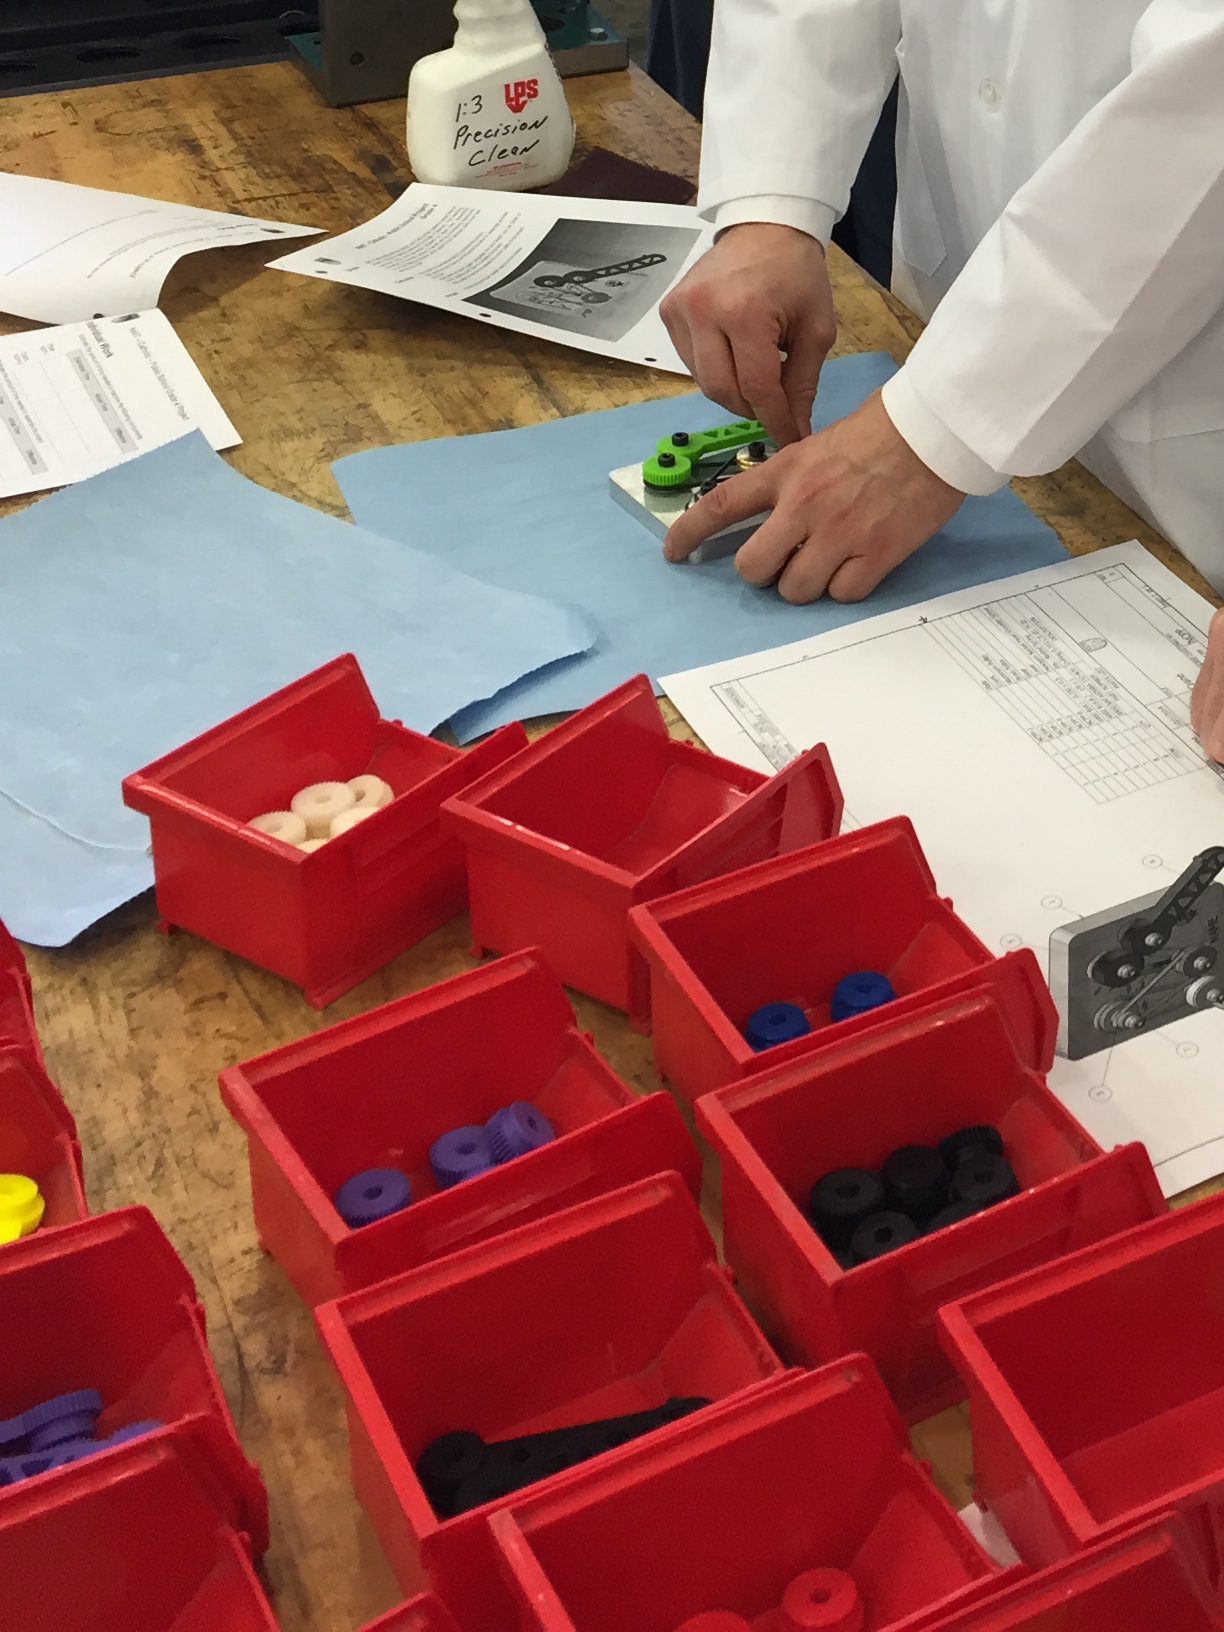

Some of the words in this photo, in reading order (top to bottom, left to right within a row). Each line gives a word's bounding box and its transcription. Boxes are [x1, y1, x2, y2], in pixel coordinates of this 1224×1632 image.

[456, 94, 483, 122] 1:3
[504, 78, 539, 114] LPS
[453, 115, 548, 150] Precision
[468, 139, 540, 166] Clean
[100, 343, 113, 358] Work
